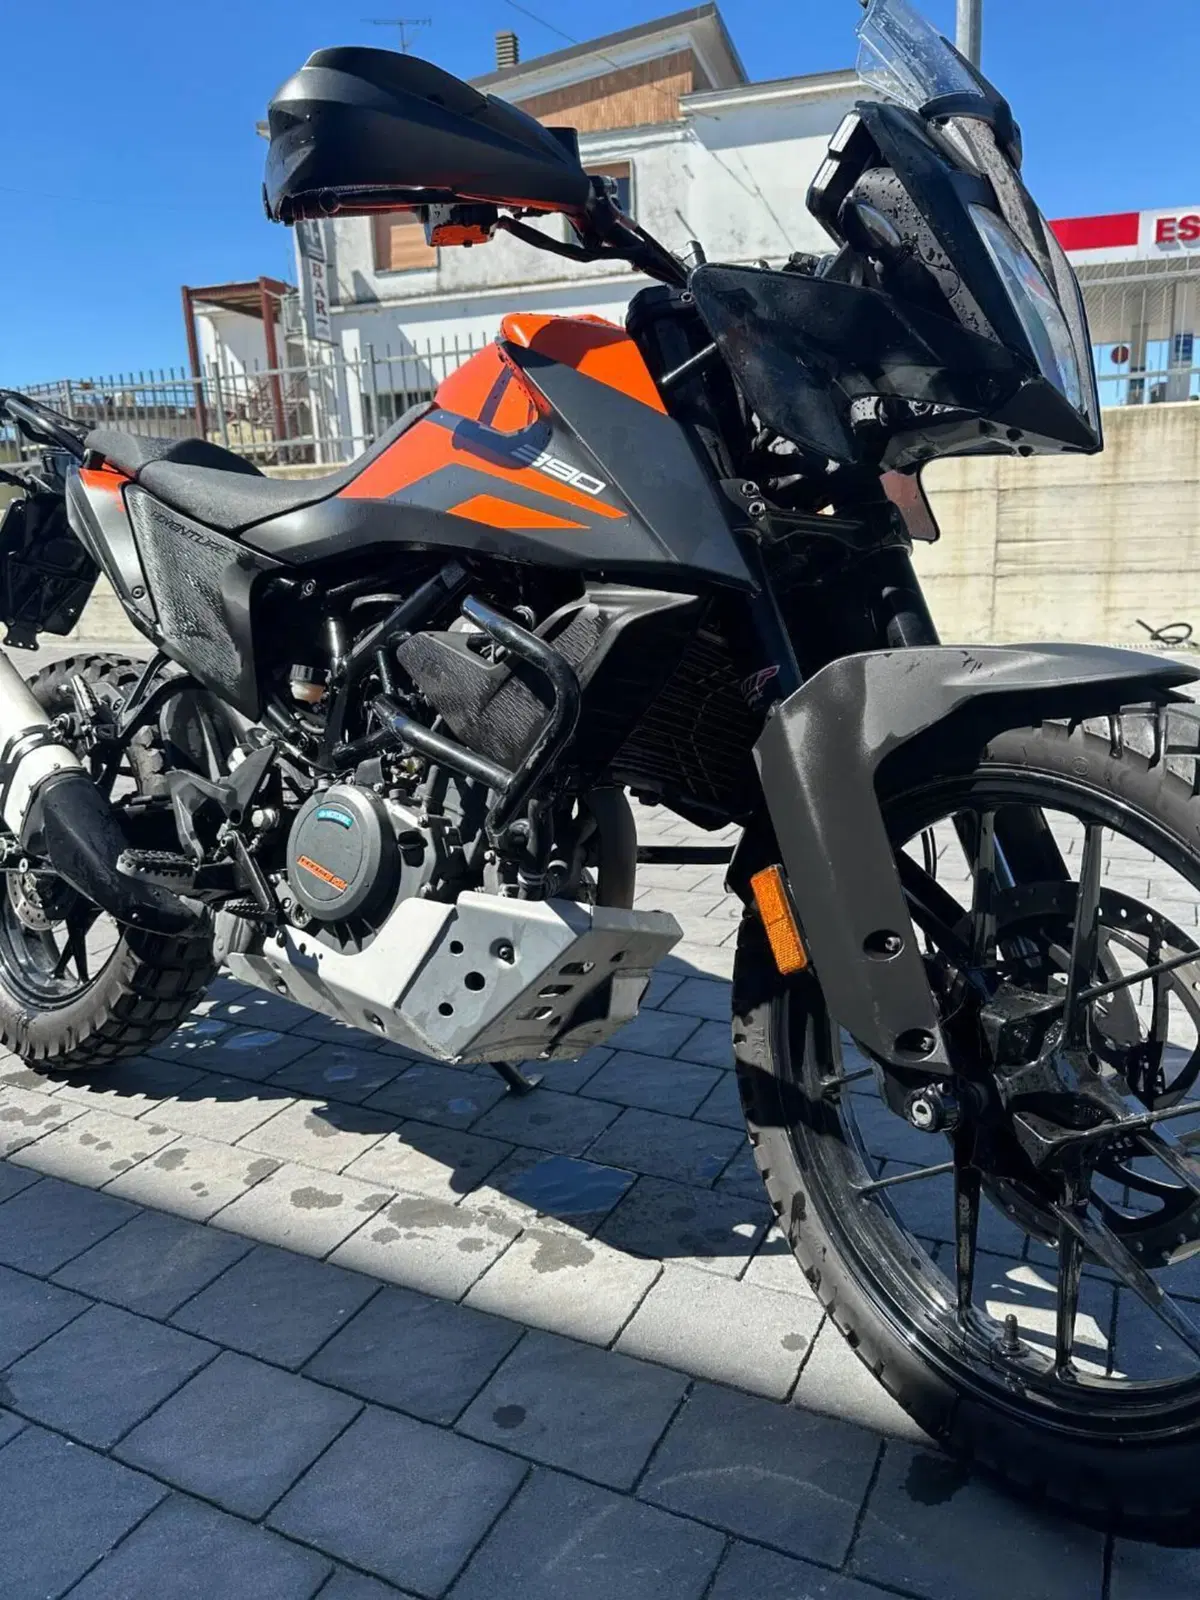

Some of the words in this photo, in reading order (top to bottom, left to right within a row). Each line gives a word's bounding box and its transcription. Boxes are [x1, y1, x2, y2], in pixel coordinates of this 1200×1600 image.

[1156, 215, 1200, 243] ES
[311, 262, 328, 317] BAR
[510, 443, 607, 495] 390
